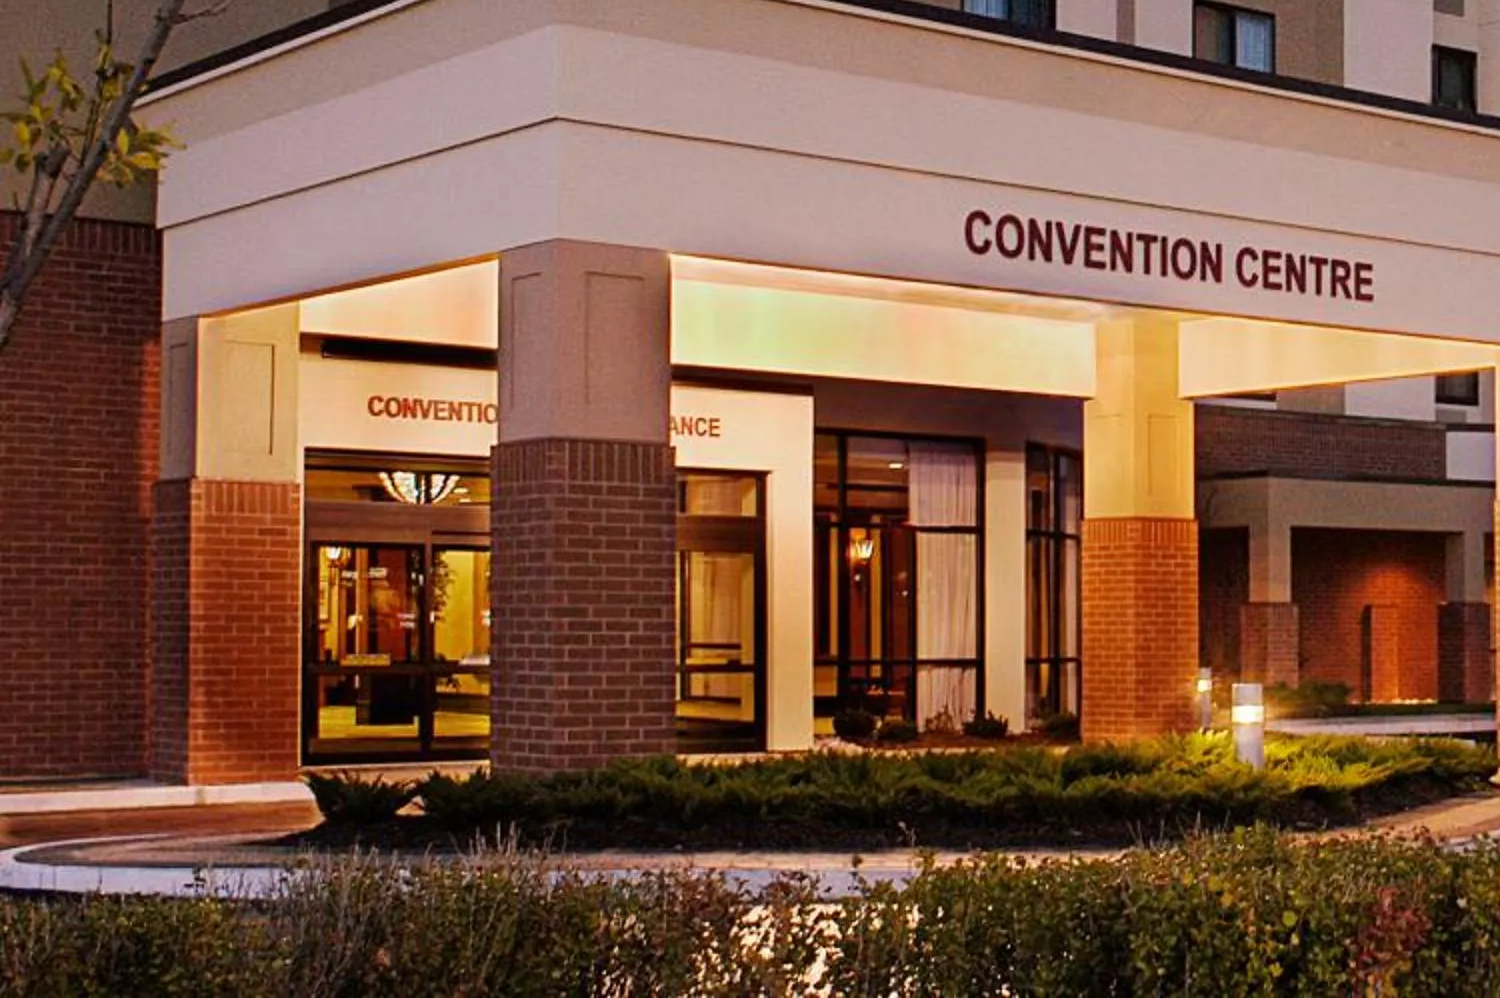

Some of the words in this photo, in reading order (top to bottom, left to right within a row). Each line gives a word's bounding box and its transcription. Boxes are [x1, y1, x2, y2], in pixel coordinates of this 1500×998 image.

[964, 209, 1223, 283] CONVENTION
[1235, 247, 1374, 302] CENTRE
[367, 395, 498, 425] CONVENTIO
